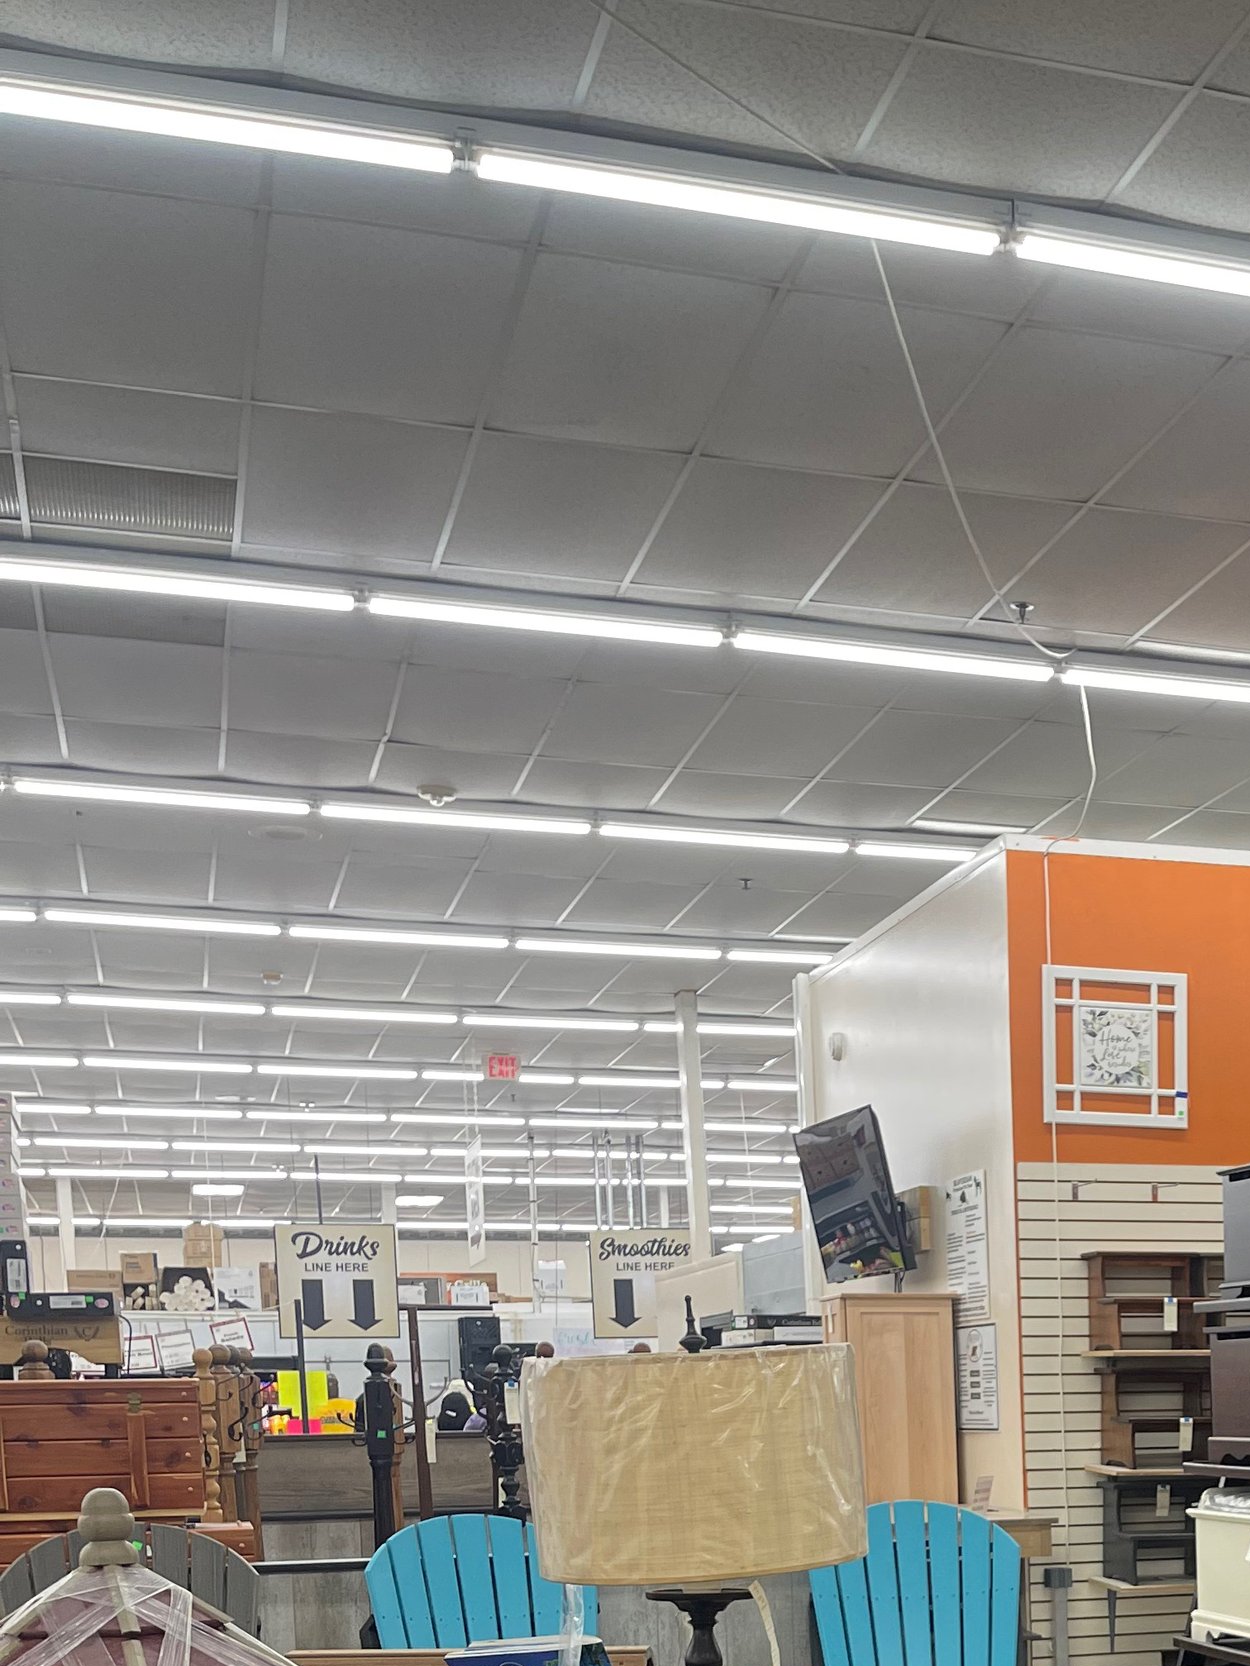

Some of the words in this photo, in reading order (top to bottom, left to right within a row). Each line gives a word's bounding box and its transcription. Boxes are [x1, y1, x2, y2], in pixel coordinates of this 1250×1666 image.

[488, 1055, 516, 1078] EXIT
[291, 1231, 380, 1260] Drinks
[599, 1237, 691, 1261] Smoothies
[304, 1262, 332, 1272] LINE
[335, 1262, 369, 1272] HERE
[616, 1262, 642, 1271] LINE
[645, 1262, 675, 1271] HERE
[5, 1324, 68, 1336] Corinthian
